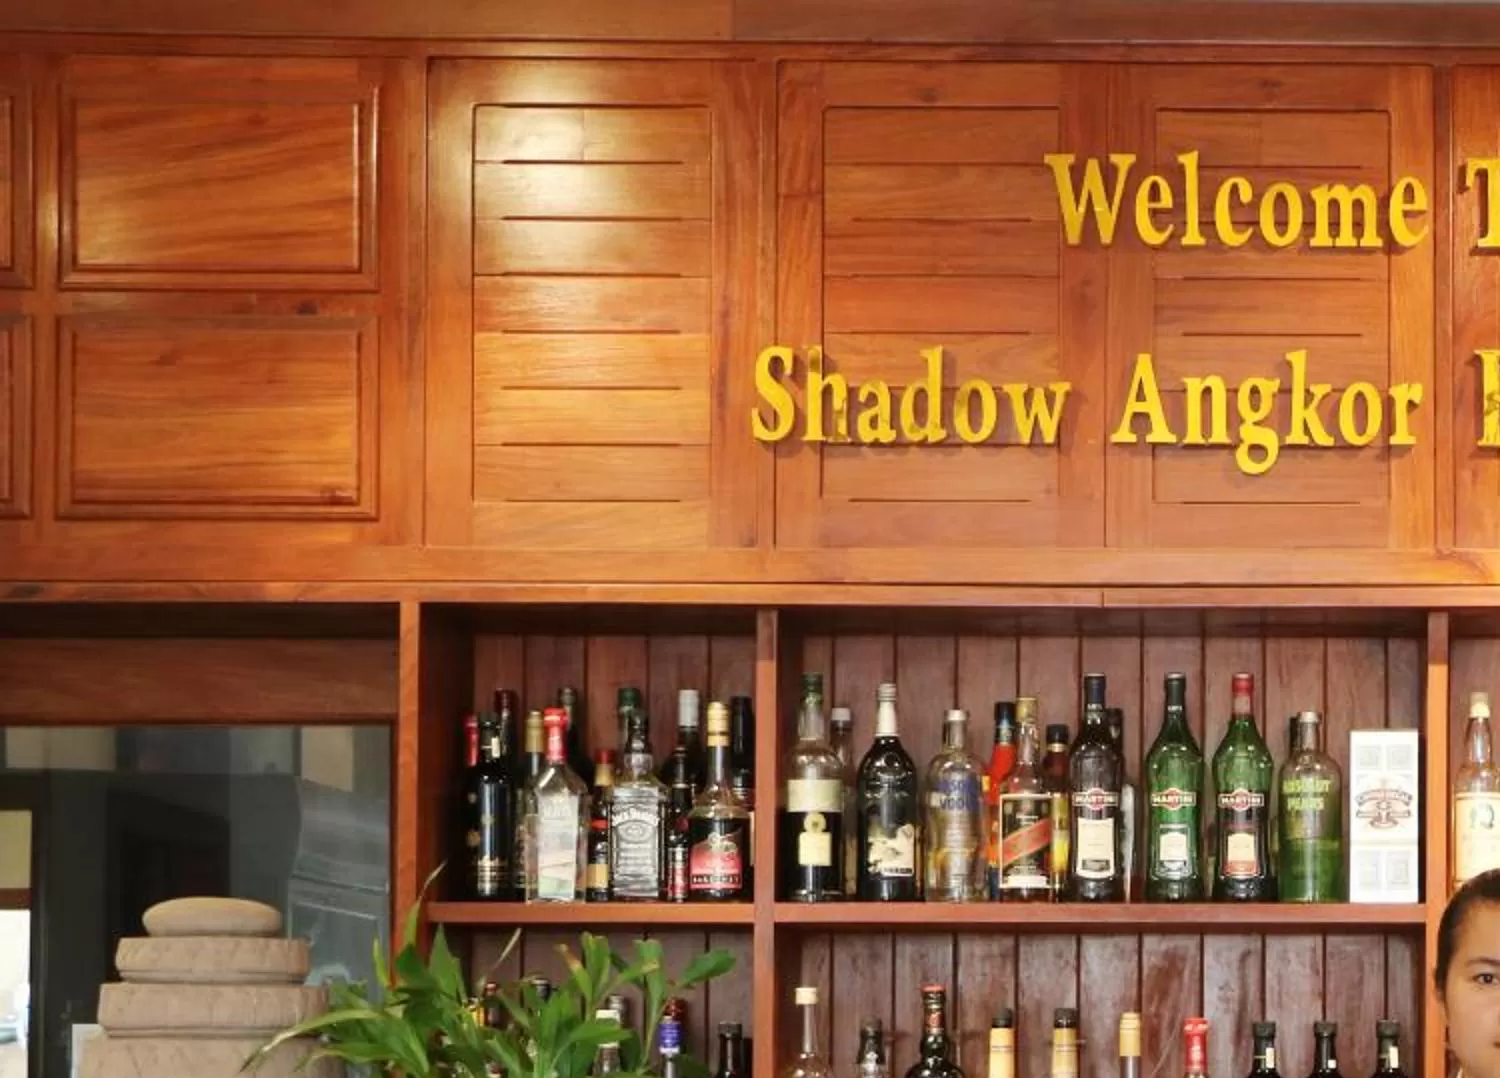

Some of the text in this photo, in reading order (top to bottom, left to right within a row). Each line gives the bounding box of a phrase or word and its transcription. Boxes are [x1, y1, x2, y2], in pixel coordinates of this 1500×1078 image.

[1045, 152, 1429, 247] Welcome
[752, 345, 1071, 444] Shadow
[1111, 350, 1424, 475] Angkor
